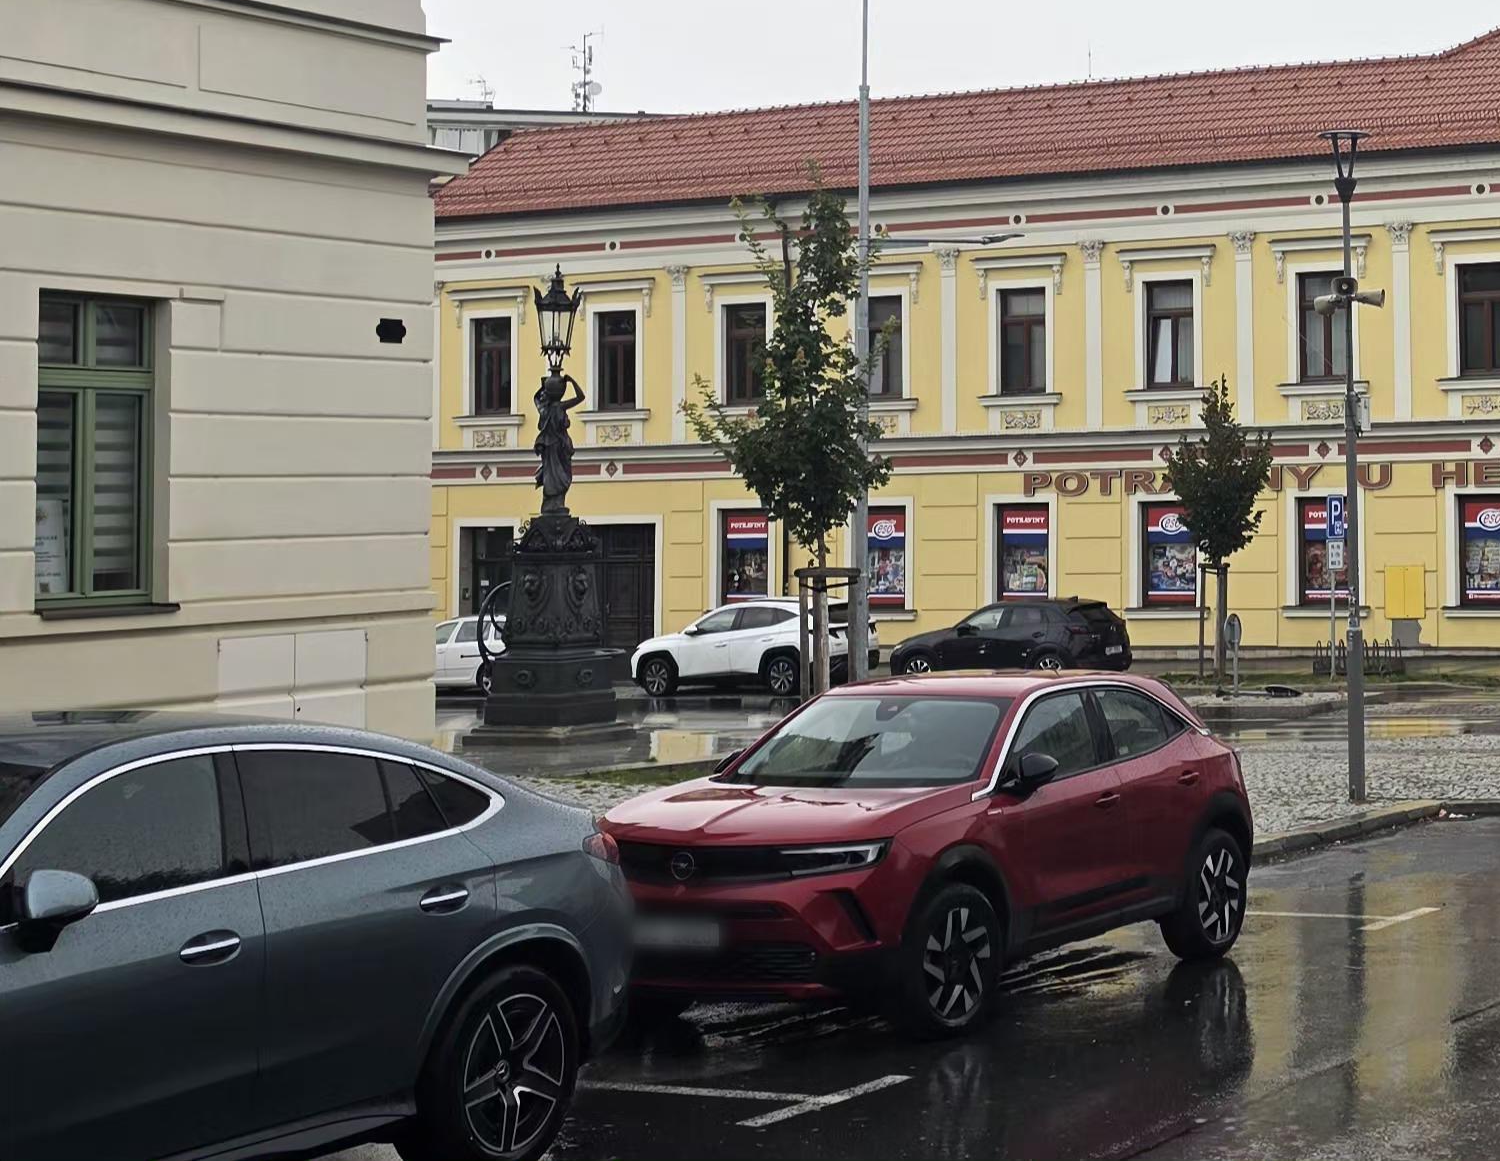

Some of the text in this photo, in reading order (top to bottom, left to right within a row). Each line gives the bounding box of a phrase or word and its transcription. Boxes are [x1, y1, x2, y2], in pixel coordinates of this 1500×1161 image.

[1356, 463, 1394, 490] U
[1331, 500, 1341, 526] P
[730, 521, 767, 530] POTRAVINY
[1006, 516, 1045, 524] POTRAVINY
[876, 523, 894, 535] eso
